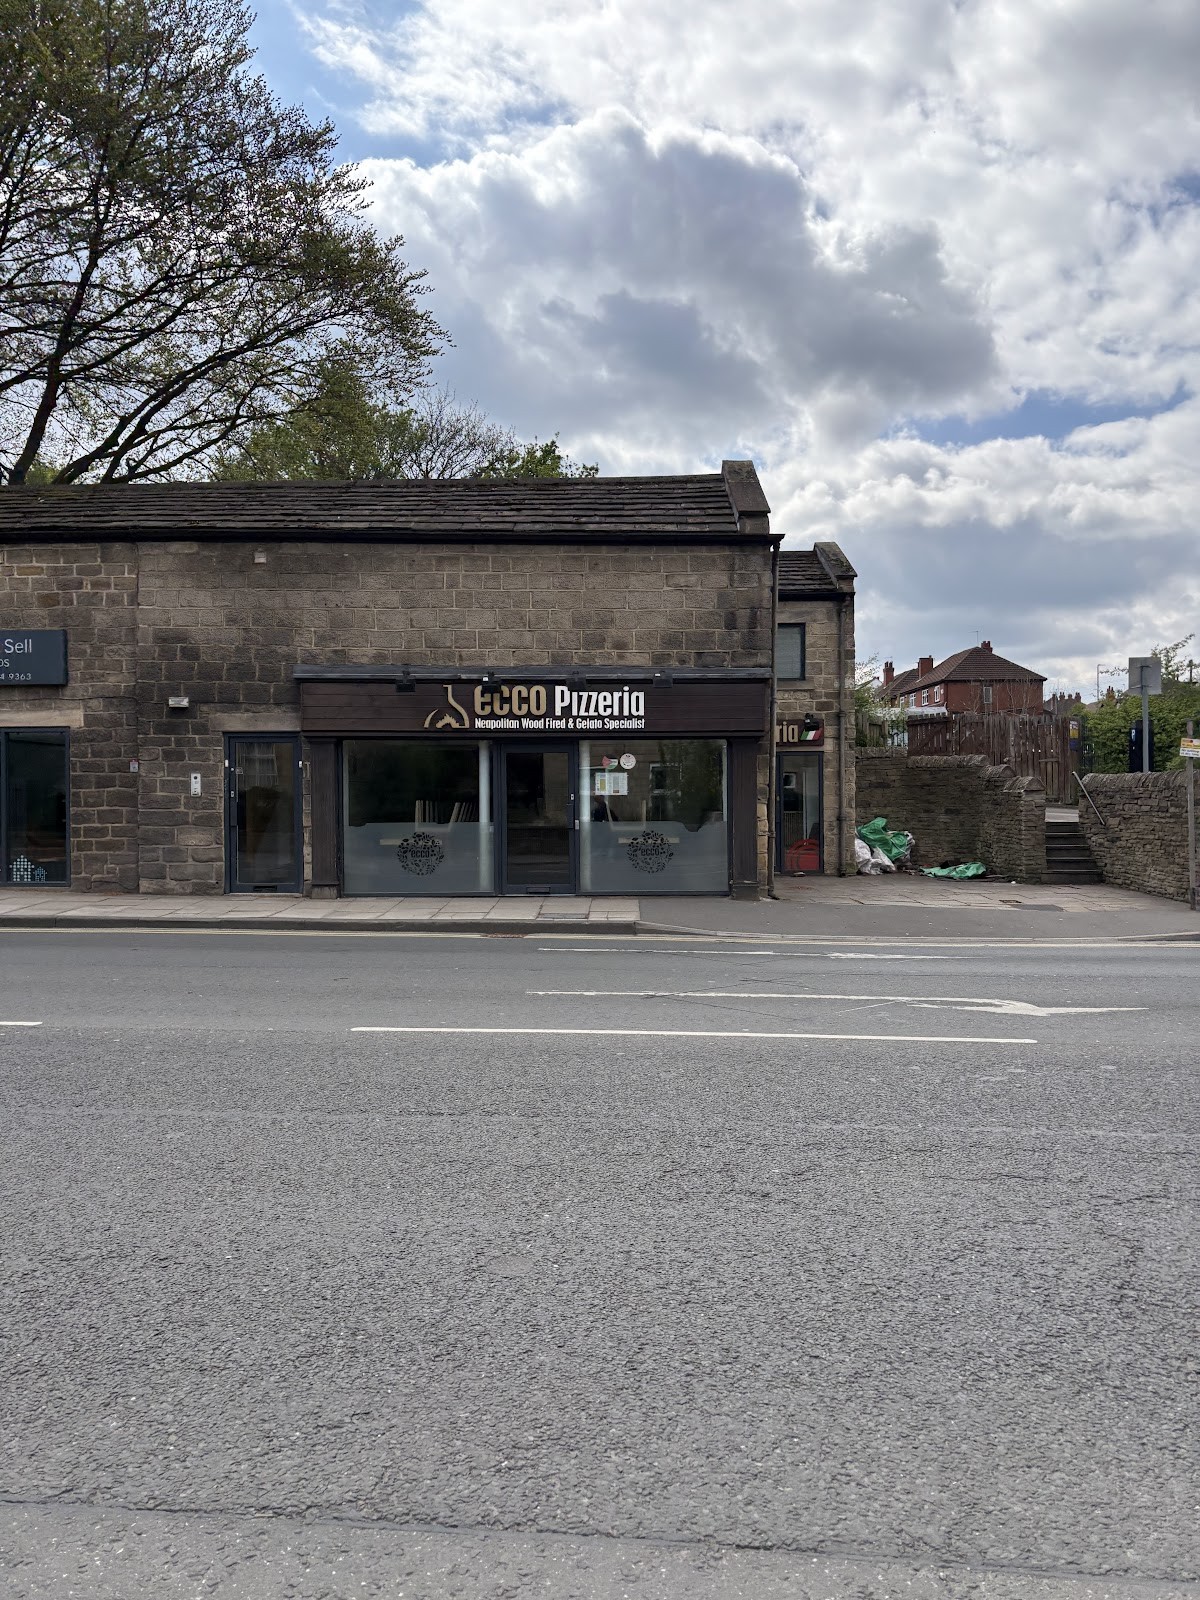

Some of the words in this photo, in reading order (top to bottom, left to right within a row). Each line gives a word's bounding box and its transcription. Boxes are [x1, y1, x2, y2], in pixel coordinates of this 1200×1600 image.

[4, 639, 32, 653] Sell
[554, 685, 645, 717] Pizzeria
[474, 717, 520, 730] Neapolitan
[521, 717, 544, 729] Wood
[545, 717, 566, 729] Fired
[567, 717, 575, 729] &
[576, 717, 603, 729] Gelato
[603, 717, 645, 730] Specialist
